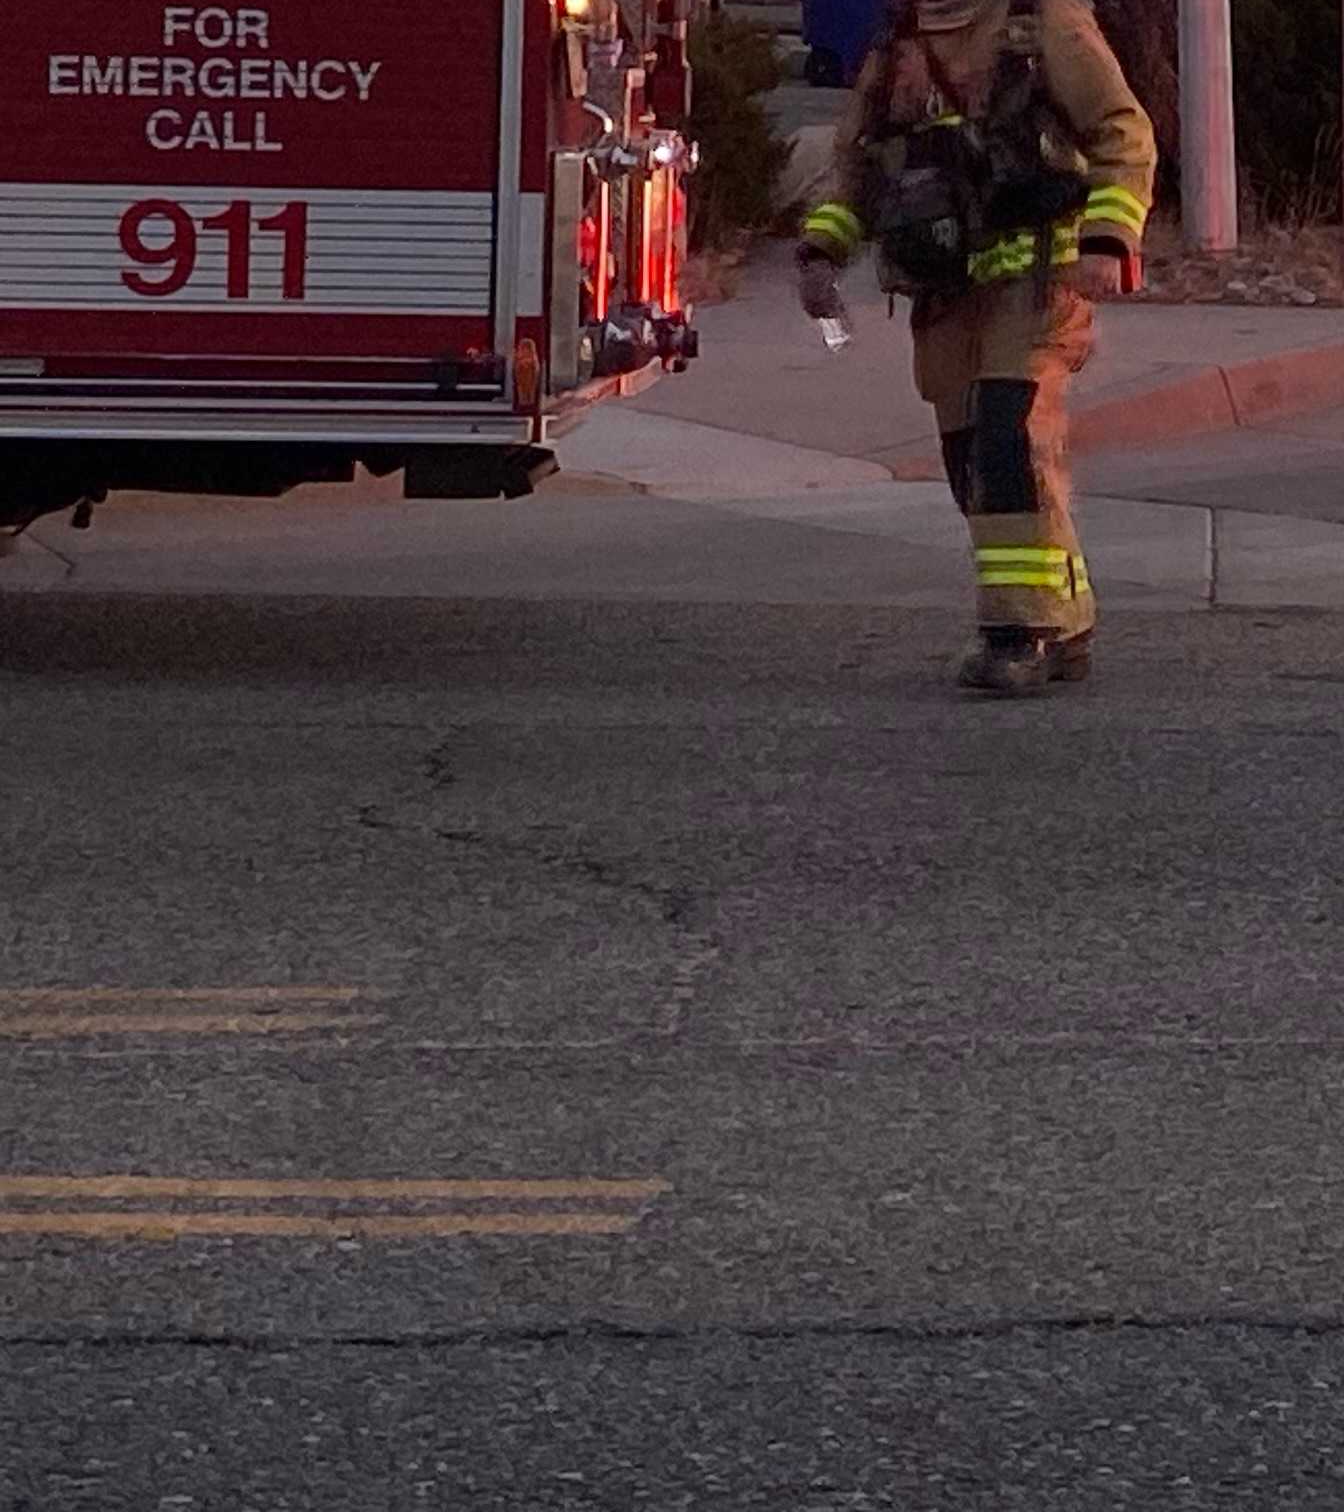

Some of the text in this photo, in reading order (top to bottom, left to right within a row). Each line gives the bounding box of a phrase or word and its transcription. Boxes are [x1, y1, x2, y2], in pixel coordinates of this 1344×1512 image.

[163, 7, 269, 49] FOR
[48, 55, 382, 101] EMERGENCY
[146, 109, 284, 152] CALL
[118, 198, 308, 300] 911
